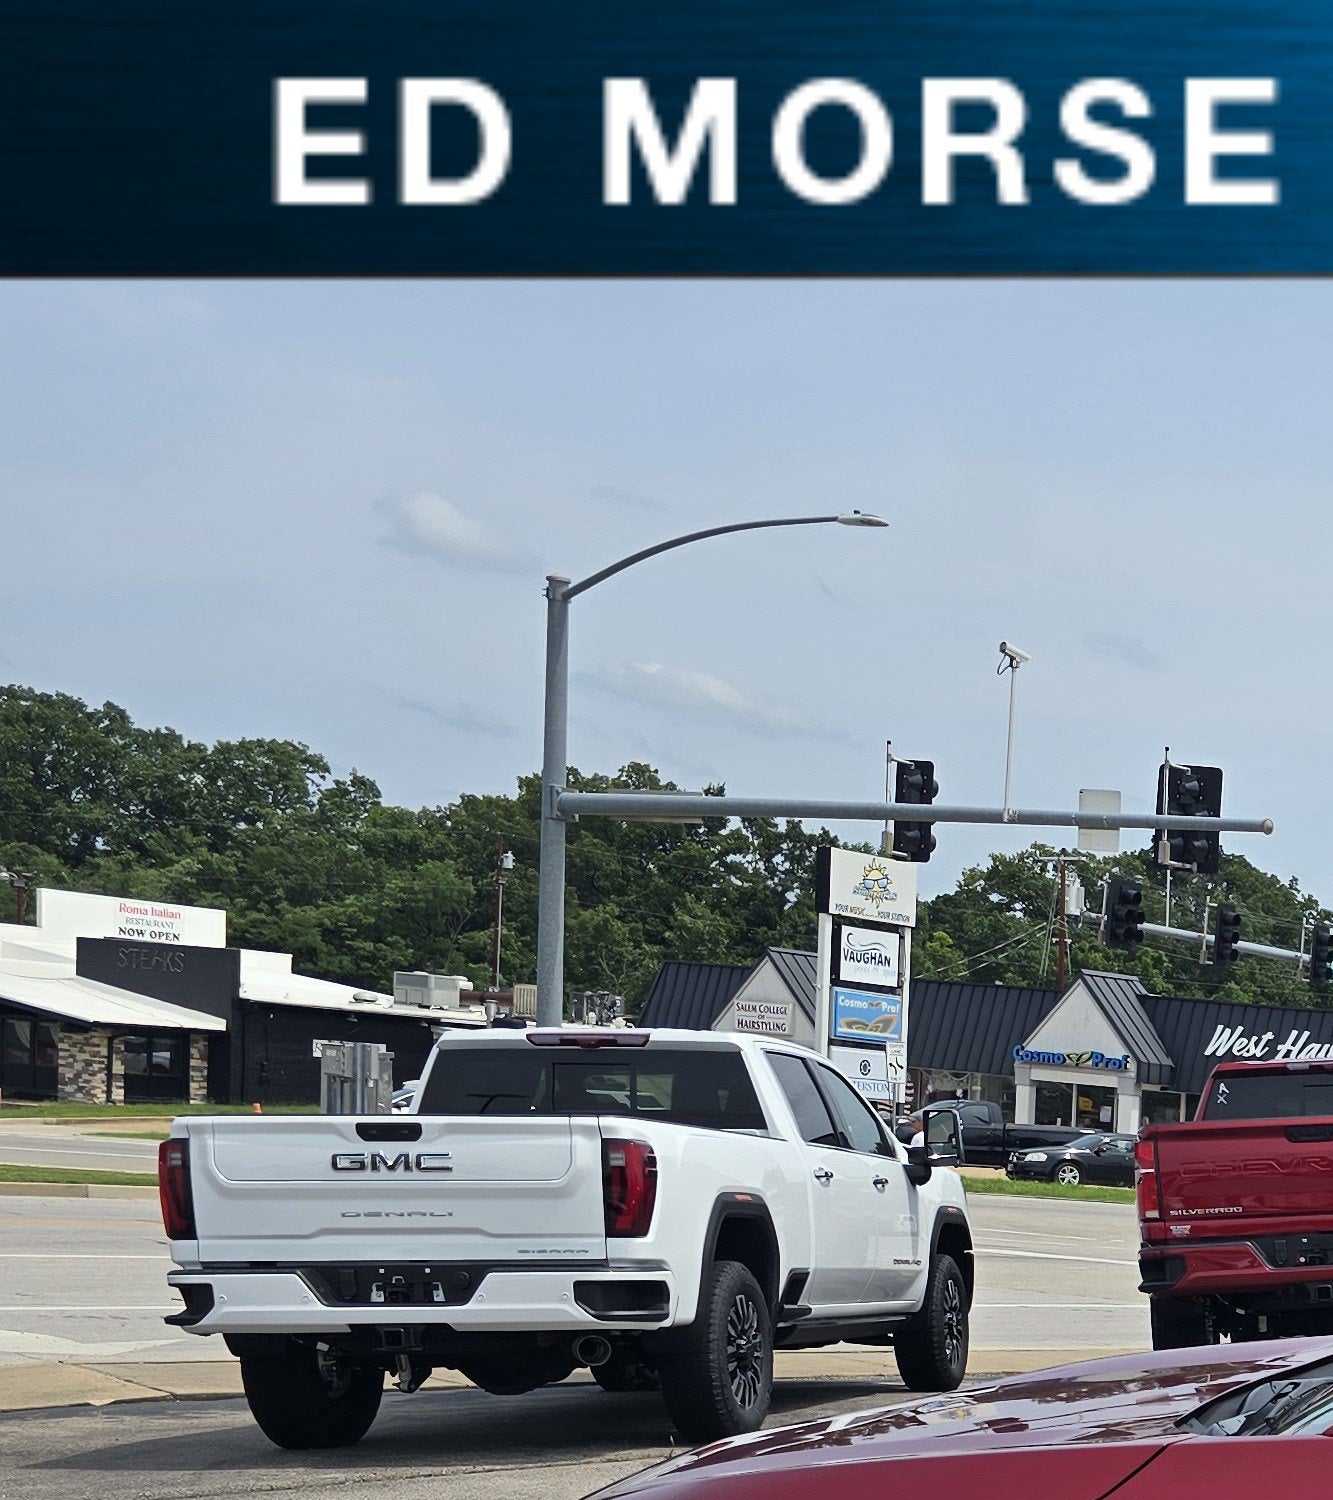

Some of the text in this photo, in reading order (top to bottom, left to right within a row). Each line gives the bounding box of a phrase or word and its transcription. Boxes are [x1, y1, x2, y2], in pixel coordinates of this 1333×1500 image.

[119, 902, 181, 919] Roma Italian
[125, 917, 175, 929] RESTAURANT
[118, 926, 180, 941] NOW OPEN
[118, 947, 185, 973] STEAKS
[843, 947, 891, 967] VAUGHAN
[736, 1002, 788, 1015] SALEM COLLEGE
[839, 996, 868, 1009] Cosmo
[737, 1018, 787, 1032] HAIRSTYLING
[1204, 1024, 1275, 1058] West
[1012, 1044, 1131, 1070] Cosmo Prof
[331, 1151, 454, 1173] GMC
[1170, 1206, 1243, 1216] SILVERADO
